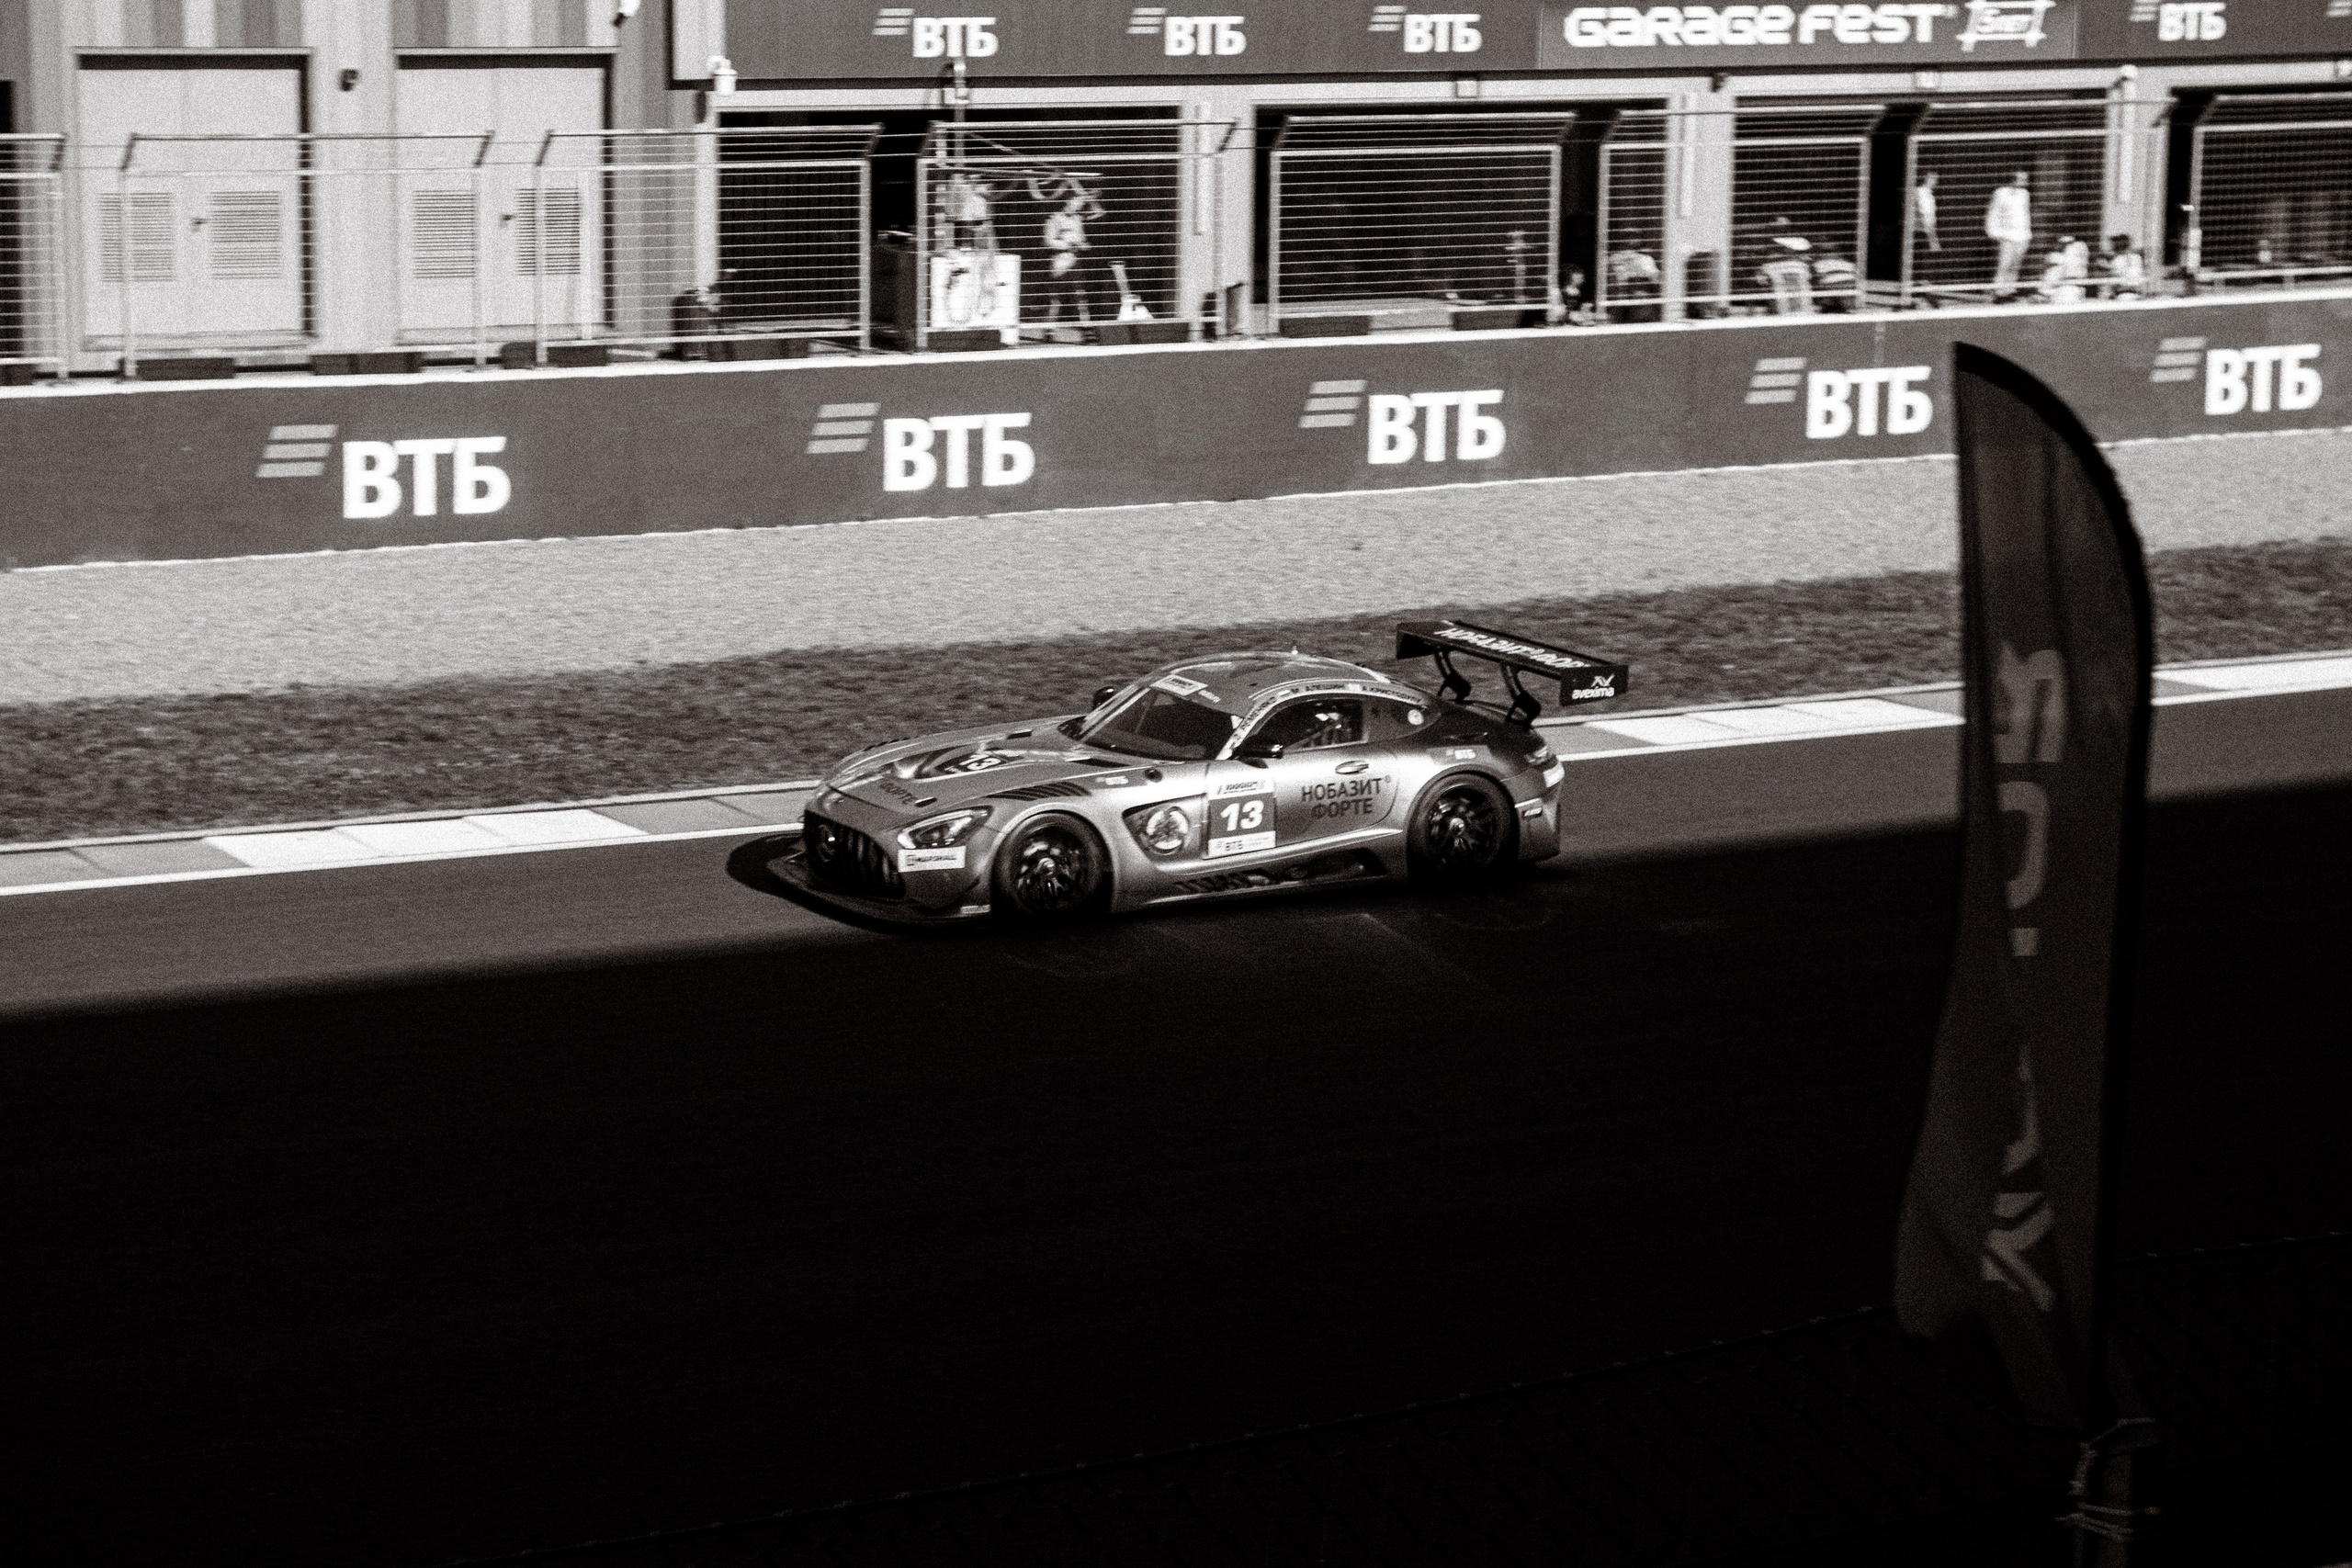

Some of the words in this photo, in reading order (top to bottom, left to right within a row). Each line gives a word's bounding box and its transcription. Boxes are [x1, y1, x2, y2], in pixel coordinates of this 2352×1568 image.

[912, 17, 999, 58] ВТБ
[1164, 16, 1246, 56] ВТБ
[1404, 14, 1482, 53] ВТБ
[2158, 2, 2227, 41] ВТБ
[2204, 344, 2323, 416] ВТБ
[1805, 366, 1933, 439] ВТБ
[1367, 389, 1507, 466] ВТБ
[883, 412, 1035, 492] ВТБ
[342, 435, 512, 519] ВТБ
[1572, 686, 1615, 700] avexima
[959, 753, 1002, 771] 13
[1301, 777, 1383, 802] НОБАЗИТ
[1310, 797, 1373, 819] ФОРТЕ
[1219, 799, 1265, 832] 13
